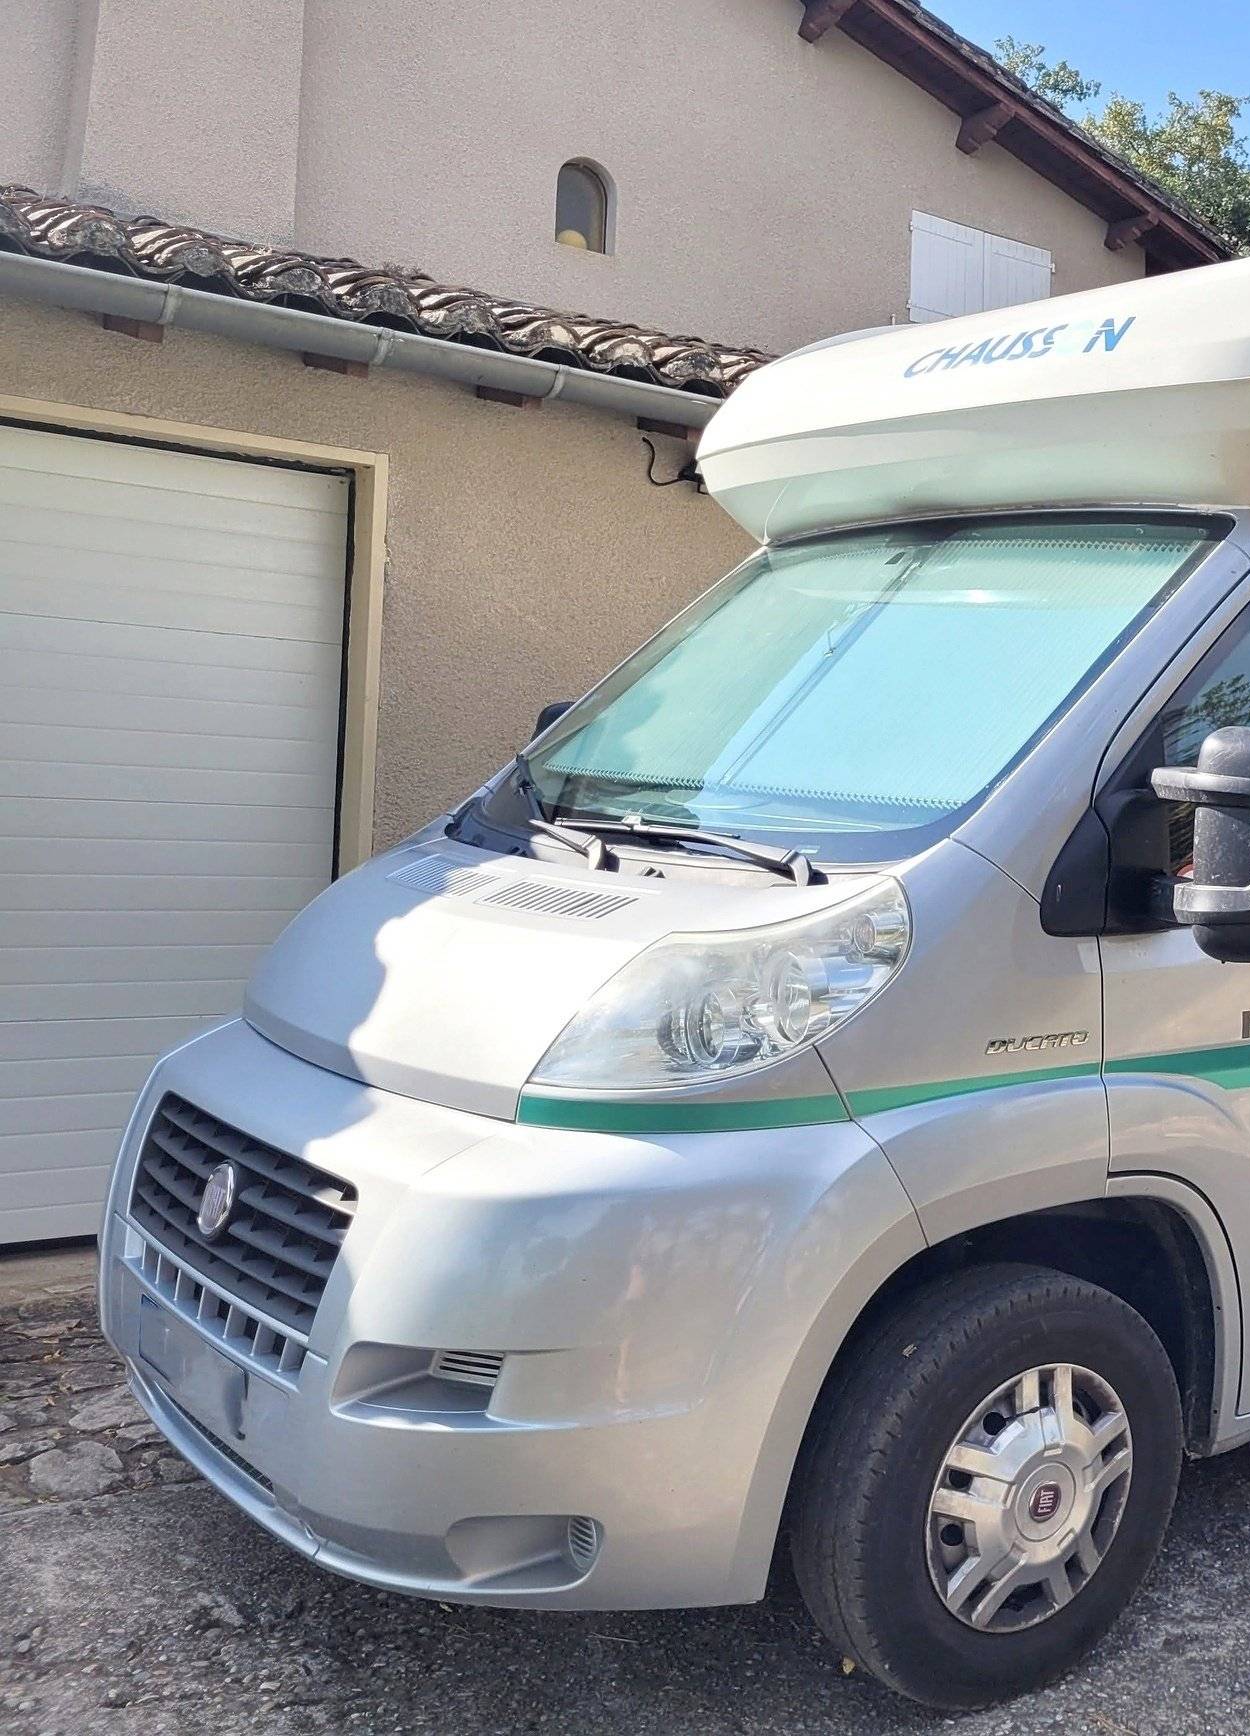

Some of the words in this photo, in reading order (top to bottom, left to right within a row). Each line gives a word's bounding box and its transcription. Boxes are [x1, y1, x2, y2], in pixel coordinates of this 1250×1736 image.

[903, 316, 1136, 378] CHAUSSN
[985, 1030, 1089, 1055] DUCATO
[1037, 1490, 1055, 1513] FIAT
